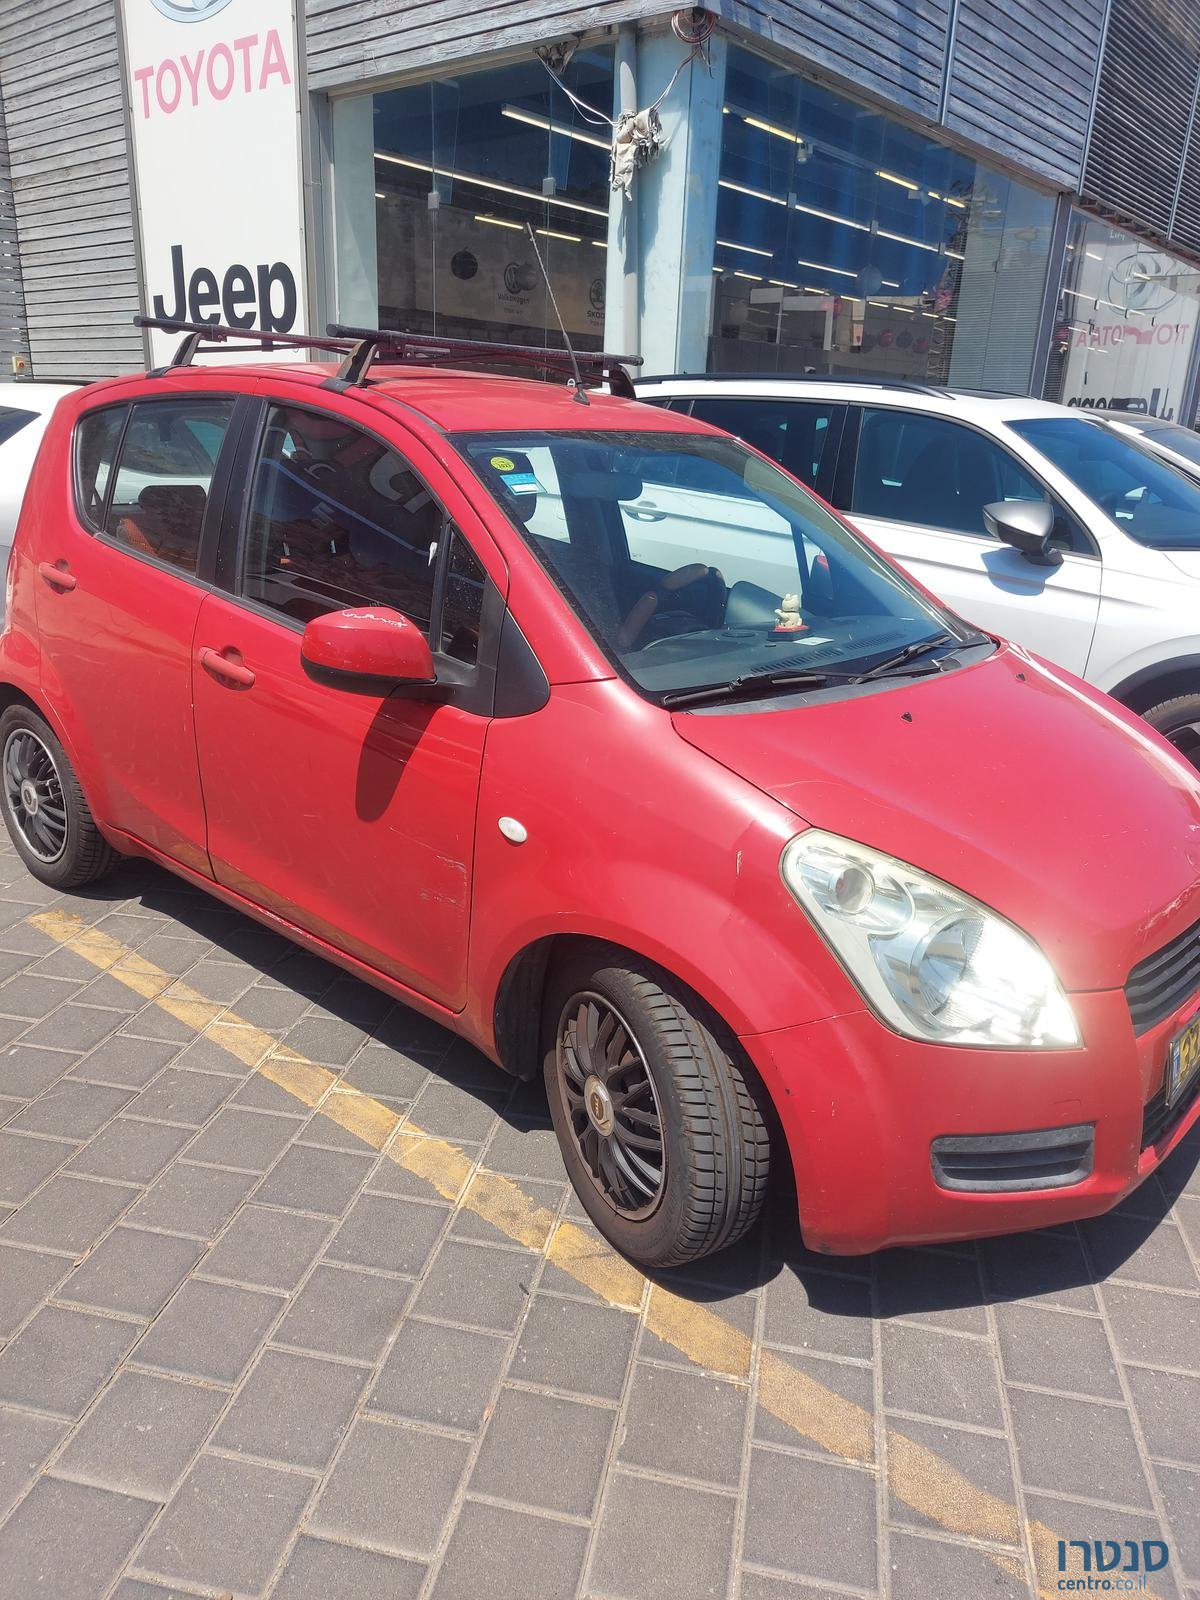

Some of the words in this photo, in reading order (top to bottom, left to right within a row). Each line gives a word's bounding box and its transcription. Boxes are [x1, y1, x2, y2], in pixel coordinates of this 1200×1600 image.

[134, 29, 291, 119] TOYOTA
[153, 244, 297, 351] Jeep
[586, 310, 605, 320] SKOD
